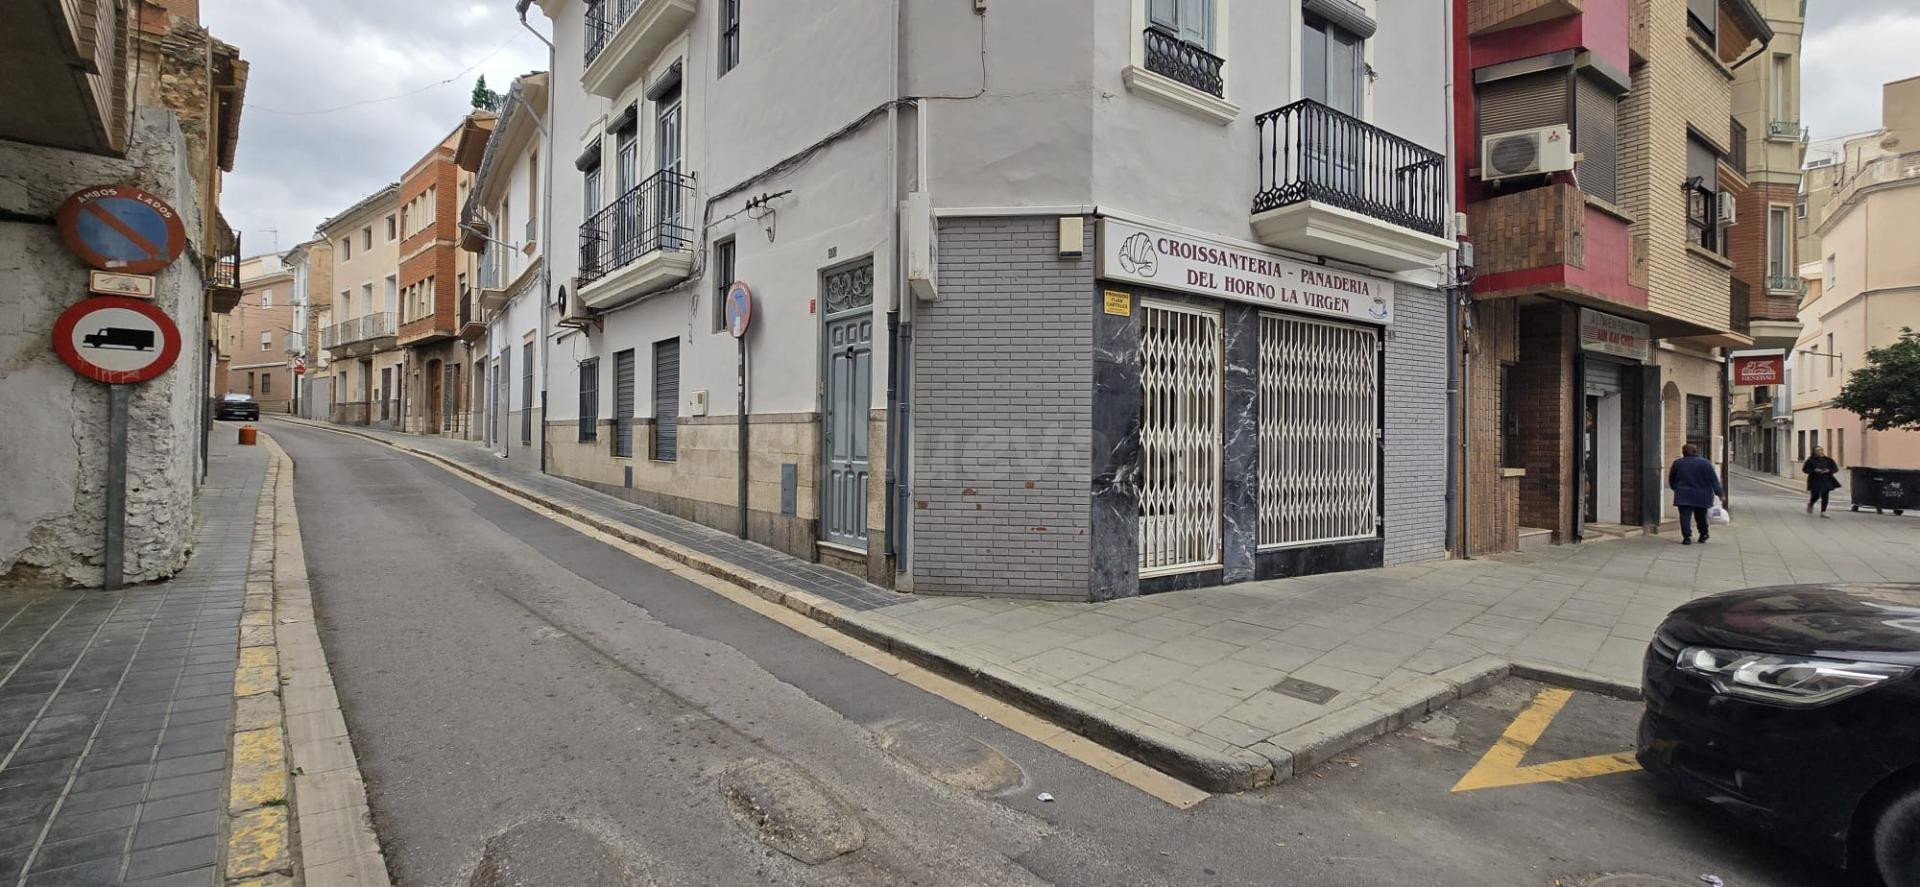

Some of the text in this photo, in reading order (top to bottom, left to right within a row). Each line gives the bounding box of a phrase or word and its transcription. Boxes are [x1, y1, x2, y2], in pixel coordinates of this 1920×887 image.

[77, 188, 173, 218] AMBOS LADOS
[1157, 238, 1282, 278] CROISSANTERIA
[1300, 268, 1370, 296] PANADERIA
[1186, 269, 1350, 313] DEL HORNO LA VIRGEN
